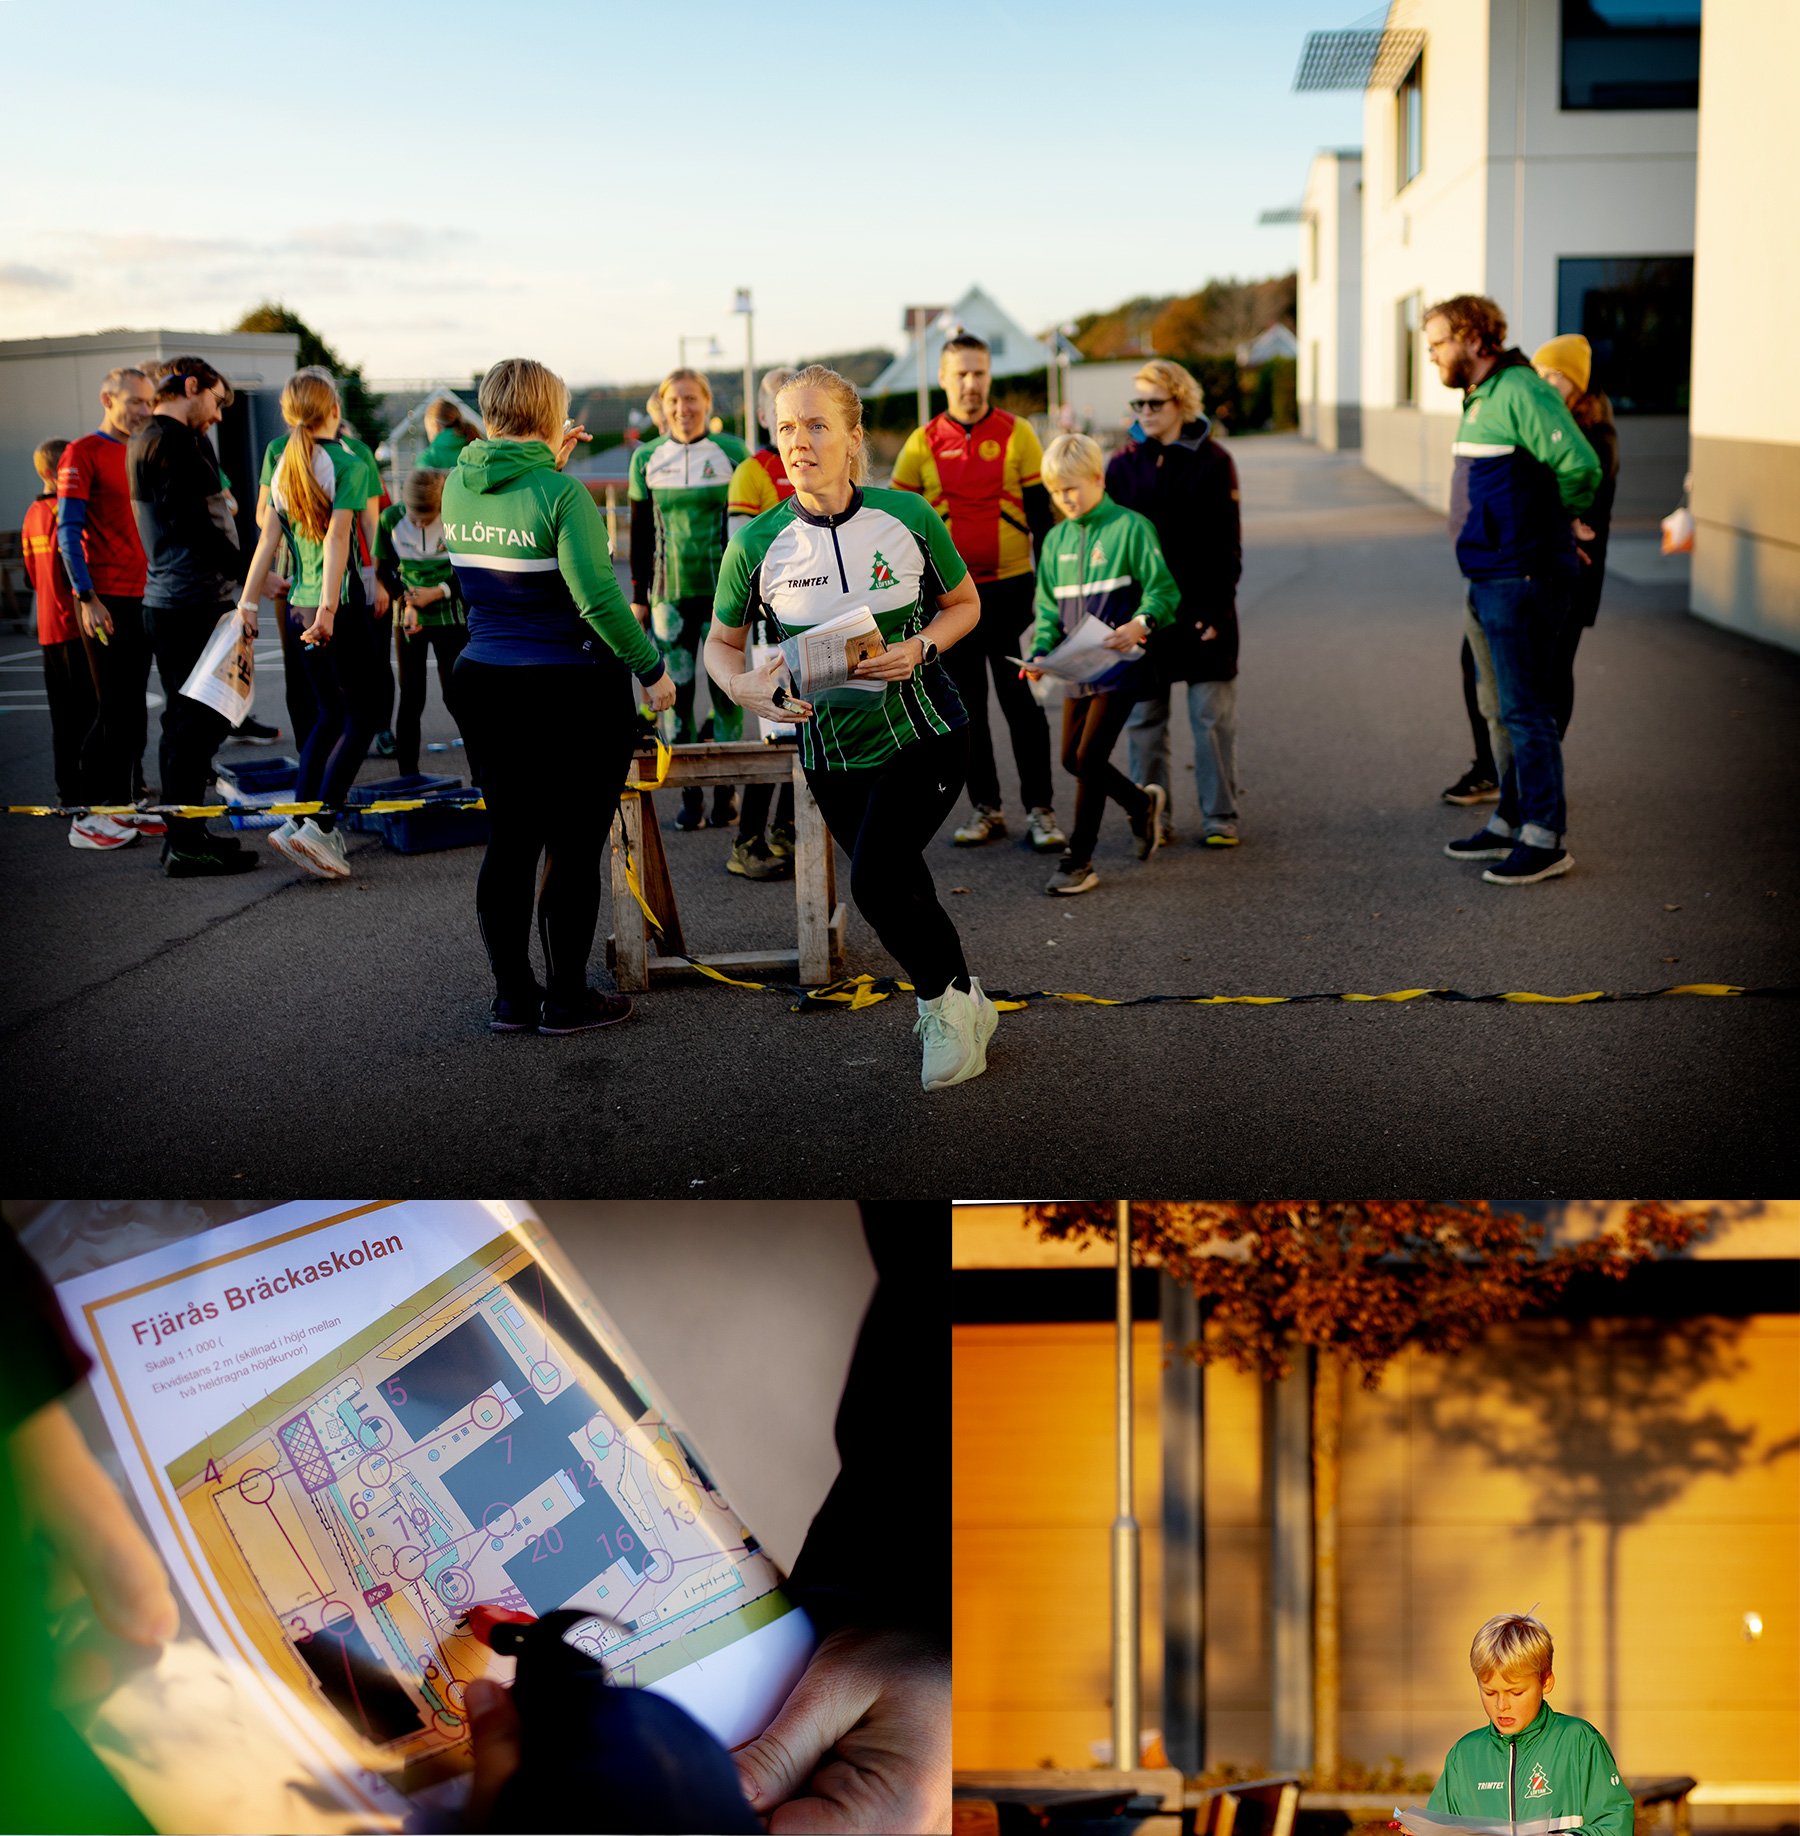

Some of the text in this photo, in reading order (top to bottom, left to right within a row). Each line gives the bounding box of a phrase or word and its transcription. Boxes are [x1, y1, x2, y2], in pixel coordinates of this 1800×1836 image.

[461, 521, 537, 548] LÖFTAN
[787, 575, 829, 588] TRIMTEX
[131, 1234, 404, 1346] Fjärås Bräckaskolan
[145, 1355, 176, 1374] Skala
[178, 1347, 194, 1361] 1:1
[196, 1338, 217, 1355] 000
[152, 1366, 212, 1394] Ekvidistans
[214, 1360, 221, 1372] 2
[222, 1357, 234, 1367] m
[235, 1340, 277, 1365] (skillnad
[284, 1329, 306, 1346] höjd
[308, 1316, 342, 1336] mellan
[179, 1343, 309, 1400] två heldragna höjdkurvor)
[385, 1376, 408, 1406] 5
[495, 1434, 513, 1465] 7
[204, 1458, 223, 1485] 4
[563, 1460, 603, 1493] 12
[349, 1492, 370, 1520] 6
[663, 1501, 696, 1532] 13
[392, 1507, 430, 1541] 19
[524, 1526, 565, 1563] 20
[596, 1524, 635, 1560] 16
[290, 1616, 315, 1644] 3
[1477, 1781, 1505, 1791] TRIMTEX
